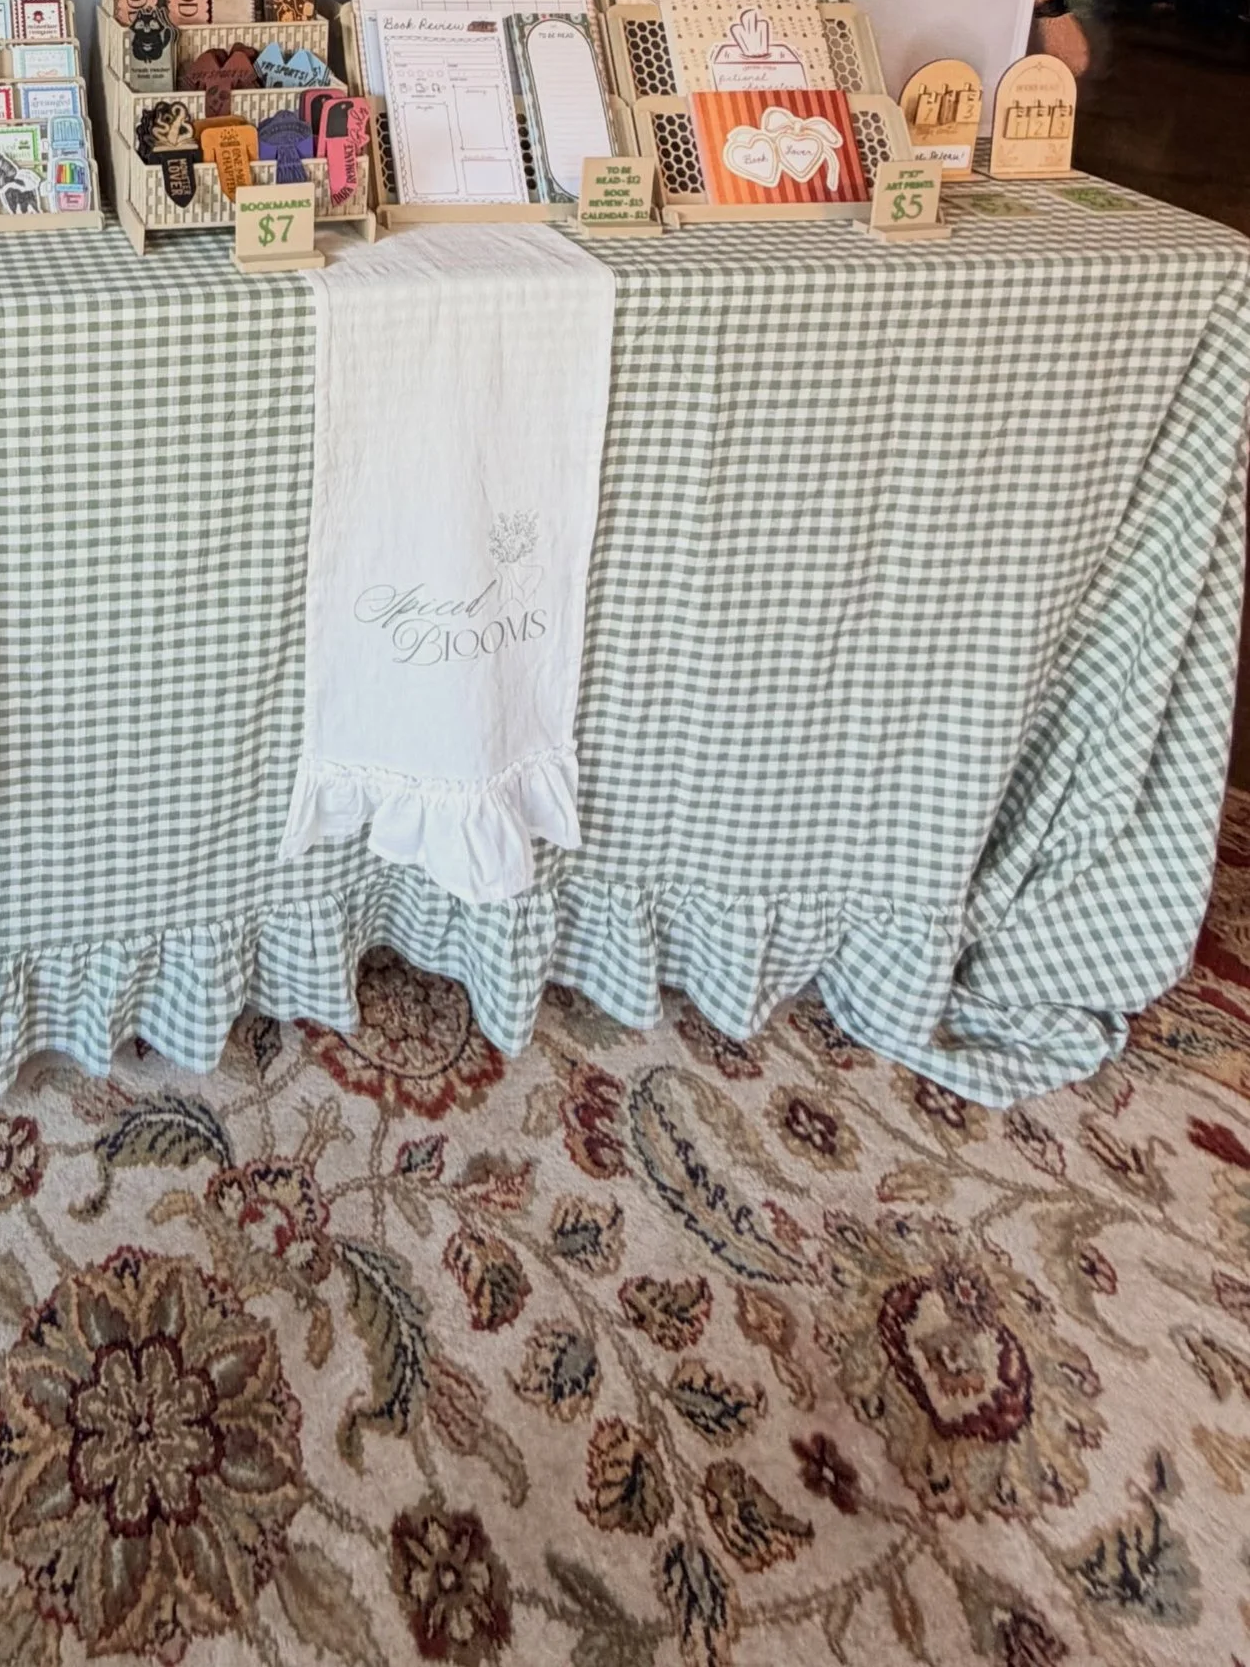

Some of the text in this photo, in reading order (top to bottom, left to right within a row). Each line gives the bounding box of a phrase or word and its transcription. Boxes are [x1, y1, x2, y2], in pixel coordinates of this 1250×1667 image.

[383, 15, 416, 30] Book
[418, 17, 465, 31] Review
[274, 64, 309, 80] SPORTS!
[233, 148, 243, 163] ONE
[784, 144, 814, 156] Lover
[742, 153, 768, 164] Book
[167, 159, 184, 196] LOVER
[180, 158, 192, 195] MONSTER
[221, 150, 236, 194] CHAPTER
[606, 166, 619, 174] TO
[626, 176, 641, 185] $12
[884, 180, 934, 191] ART PRINTS
[604, 189, 630, 197] BOOK
[240, 198, 311, 212] BOOKMARKS
[589, 199, 623, 207] REVIEW
[891, 192, 923, 222] $5
[258, 213, 295, 247] $7
[392, 609, 547, 666] BLOOMS
